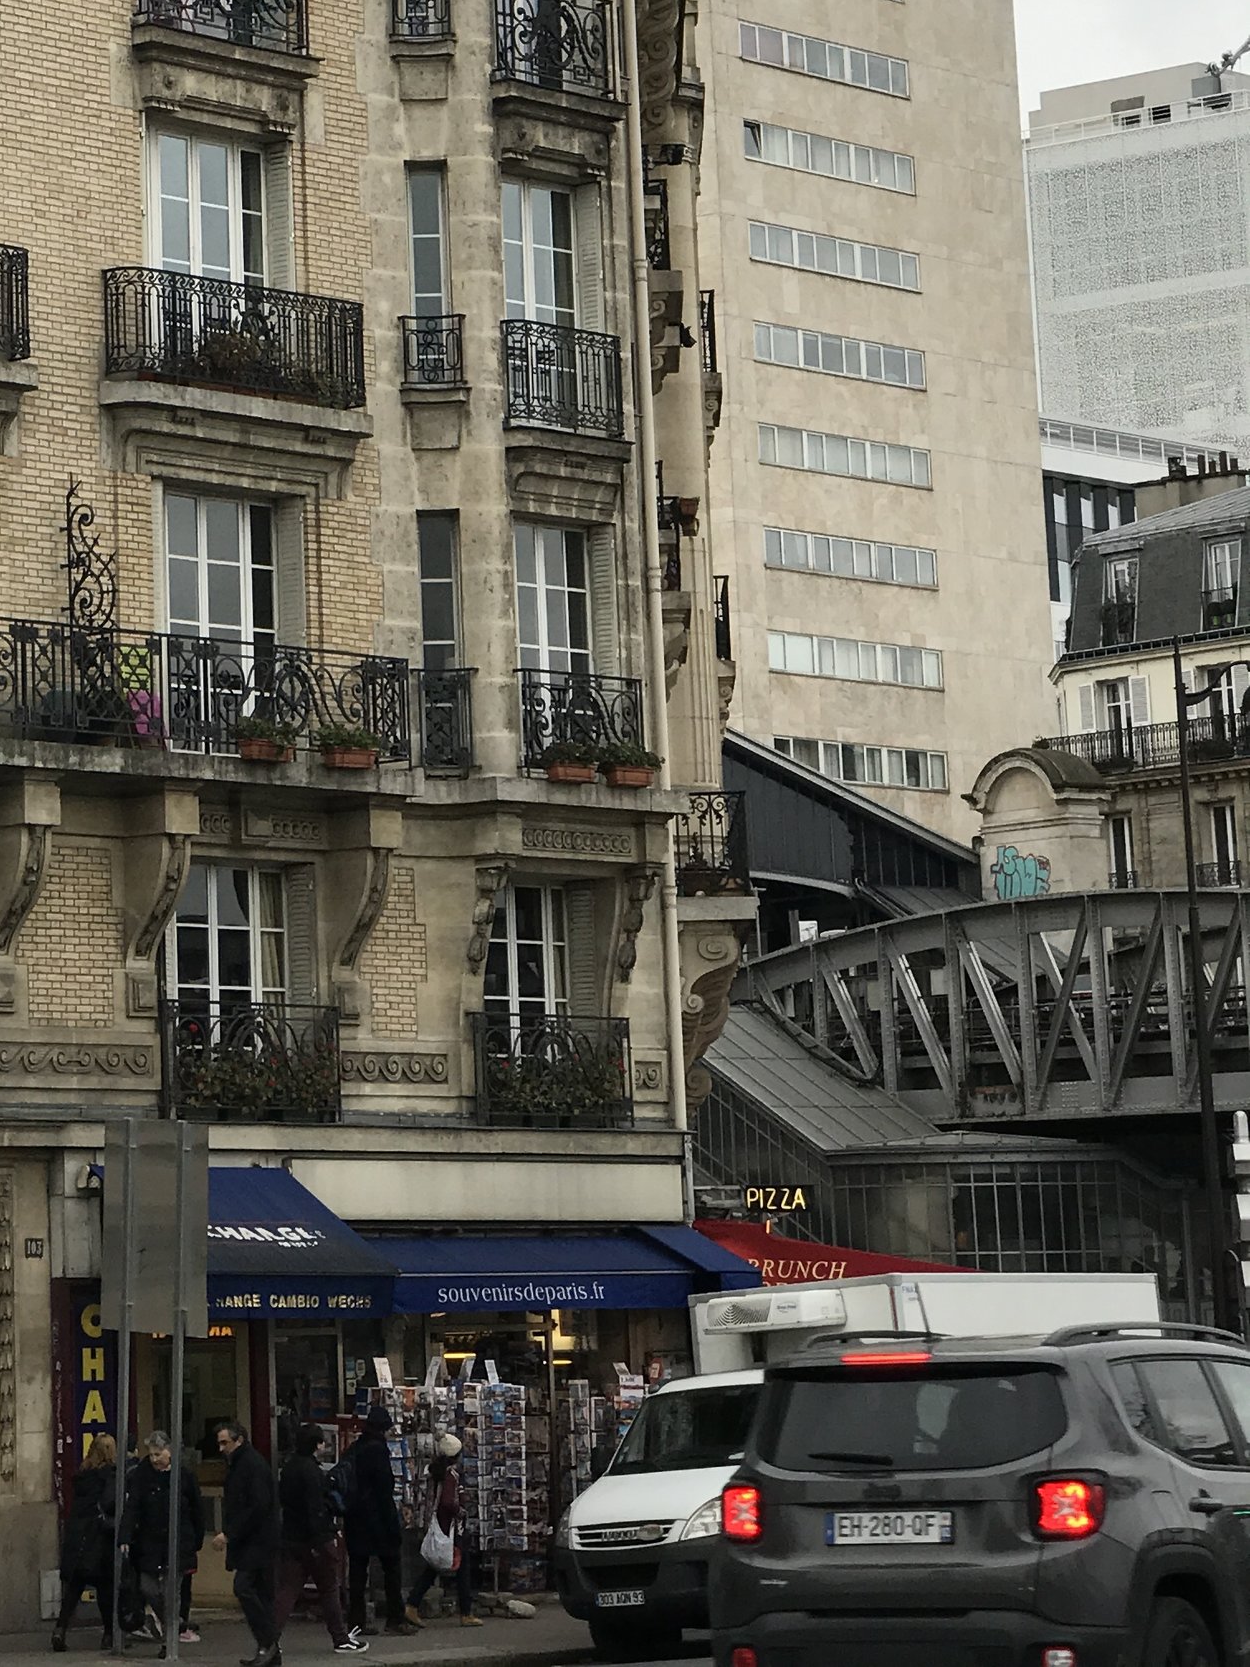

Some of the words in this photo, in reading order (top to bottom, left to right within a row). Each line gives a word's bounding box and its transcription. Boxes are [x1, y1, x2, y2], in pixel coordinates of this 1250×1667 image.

[747, 1188, 806, 1210] PIZZA
[27, 1241, 41, 1254] 103
[209, 1294, 261, 1308] HANGE
[269, 1295, 320, 1309] CAMBIO
[438, 1281, 605, 1305] souvenirsdeparis.fr
[838, 1515, 936, 1537] EH-280-QF
